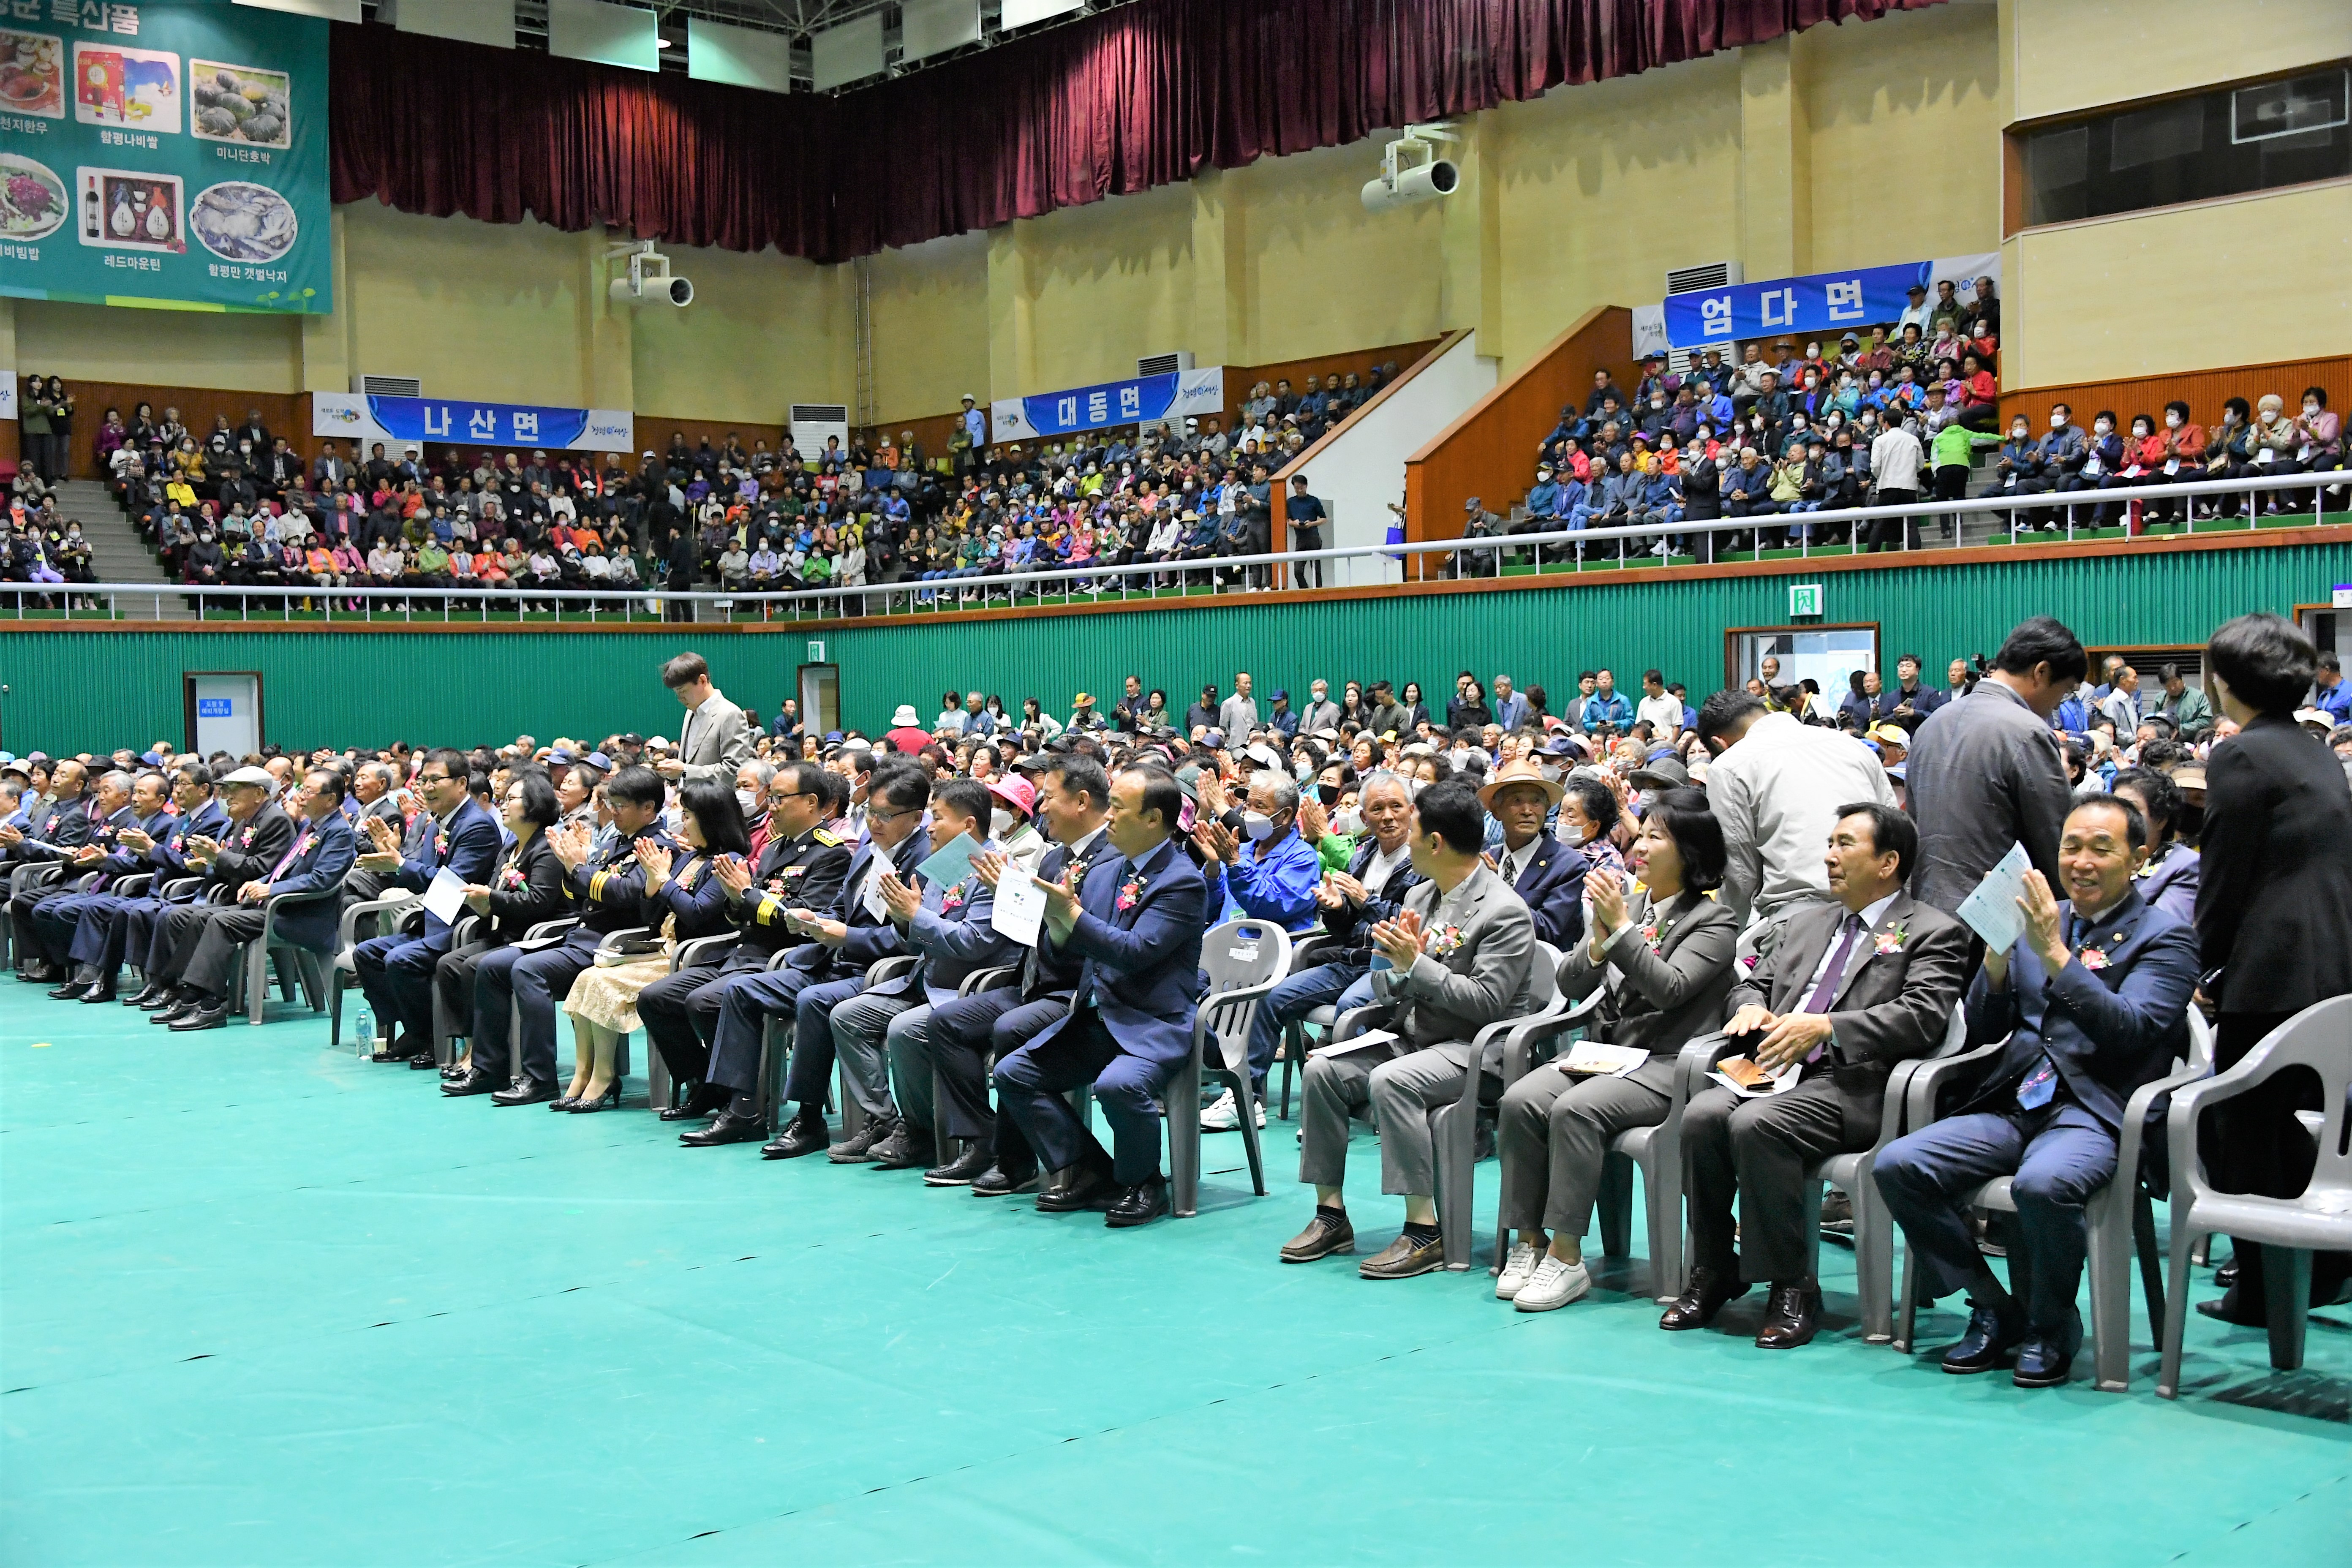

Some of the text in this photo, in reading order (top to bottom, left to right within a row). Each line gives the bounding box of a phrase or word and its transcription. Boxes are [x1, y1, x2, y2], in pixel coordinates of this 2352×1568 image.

[51, 0, 139, 35] 특산품
[101, 131, 158, 149] 함평나비쌀
[217, 147, 271, 165] 미니단호박
[0, 244, 39, 261] 비빔밥
[104, 255, 161, 271] 레드마운틴
[209, 263, 287, 283] 함평만 갯벌낙지
